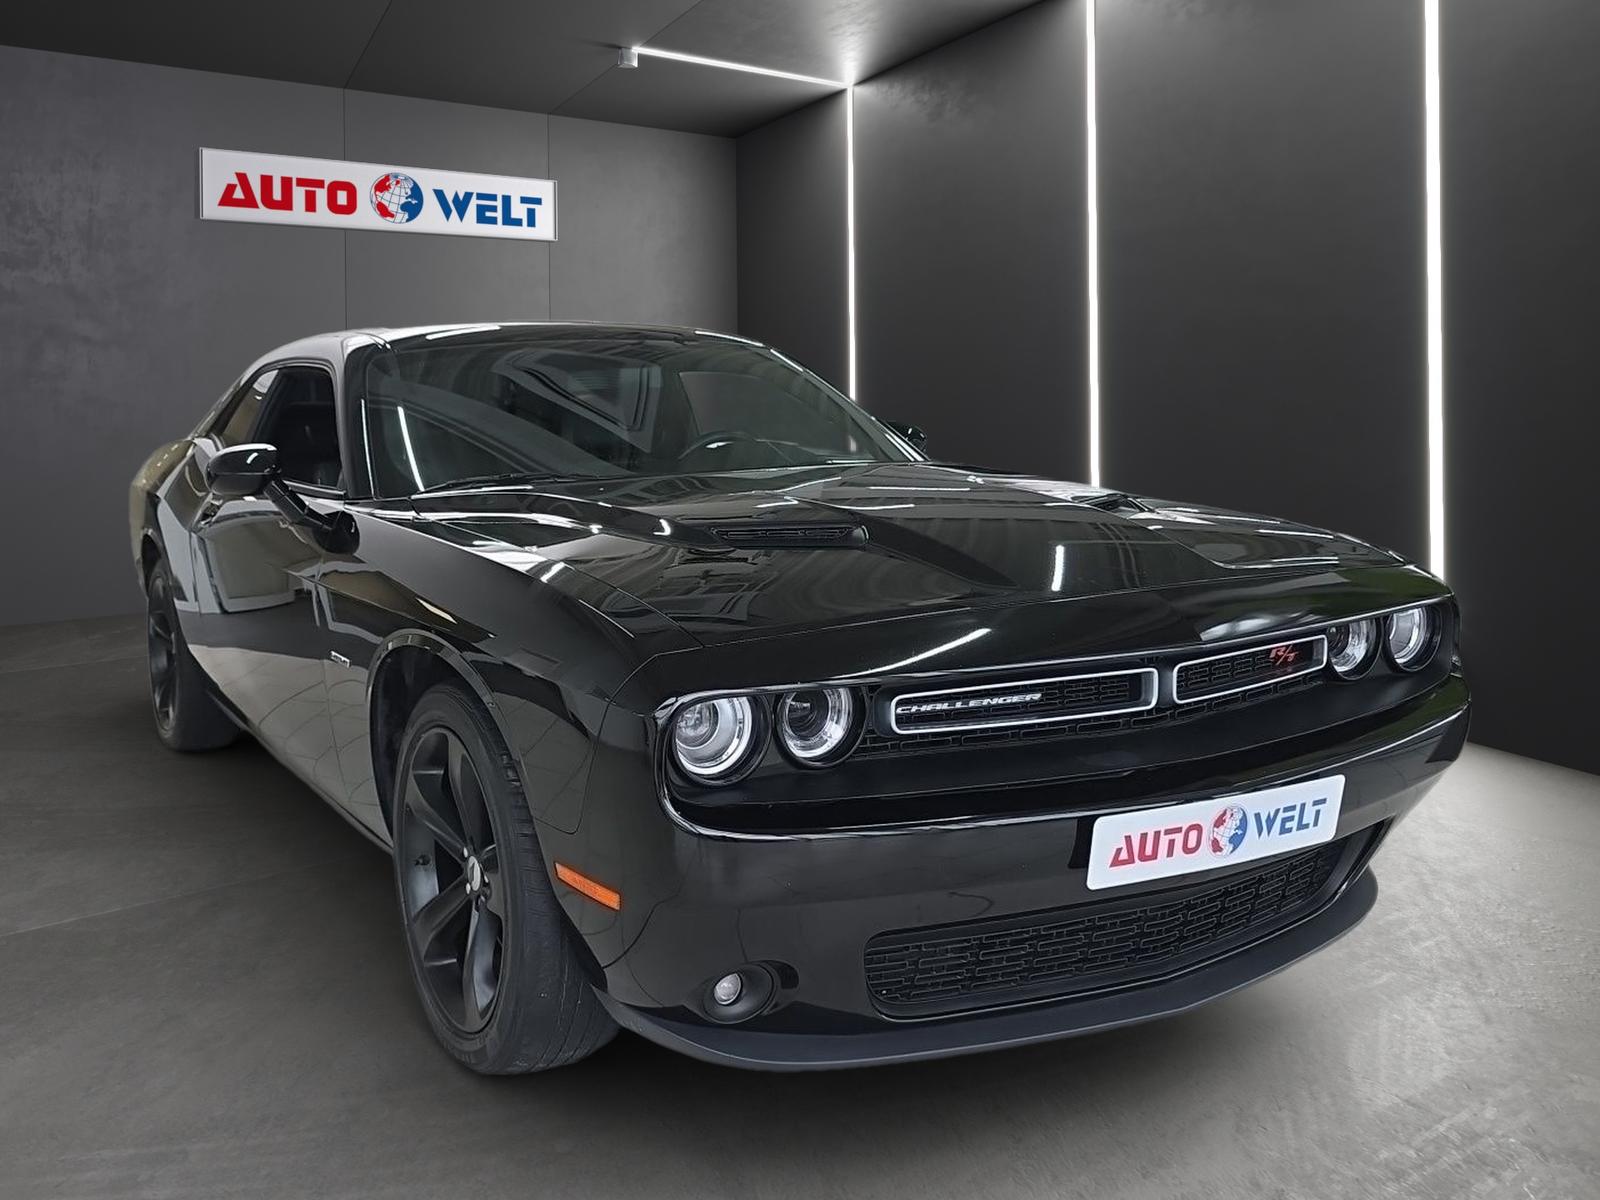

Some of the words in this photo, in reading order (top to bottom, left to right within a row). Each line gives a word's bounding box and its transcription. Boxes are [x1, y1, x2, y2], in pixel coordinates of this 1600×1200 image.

[218, 172, 357, 215] AUTO
[433, 189, 542, 227] WELT
[896, 694, 1042, 714] CHALLENGER
[1109, 823, 1203, 868] AUTO
[1254, 798, 1327, 840] WELT
